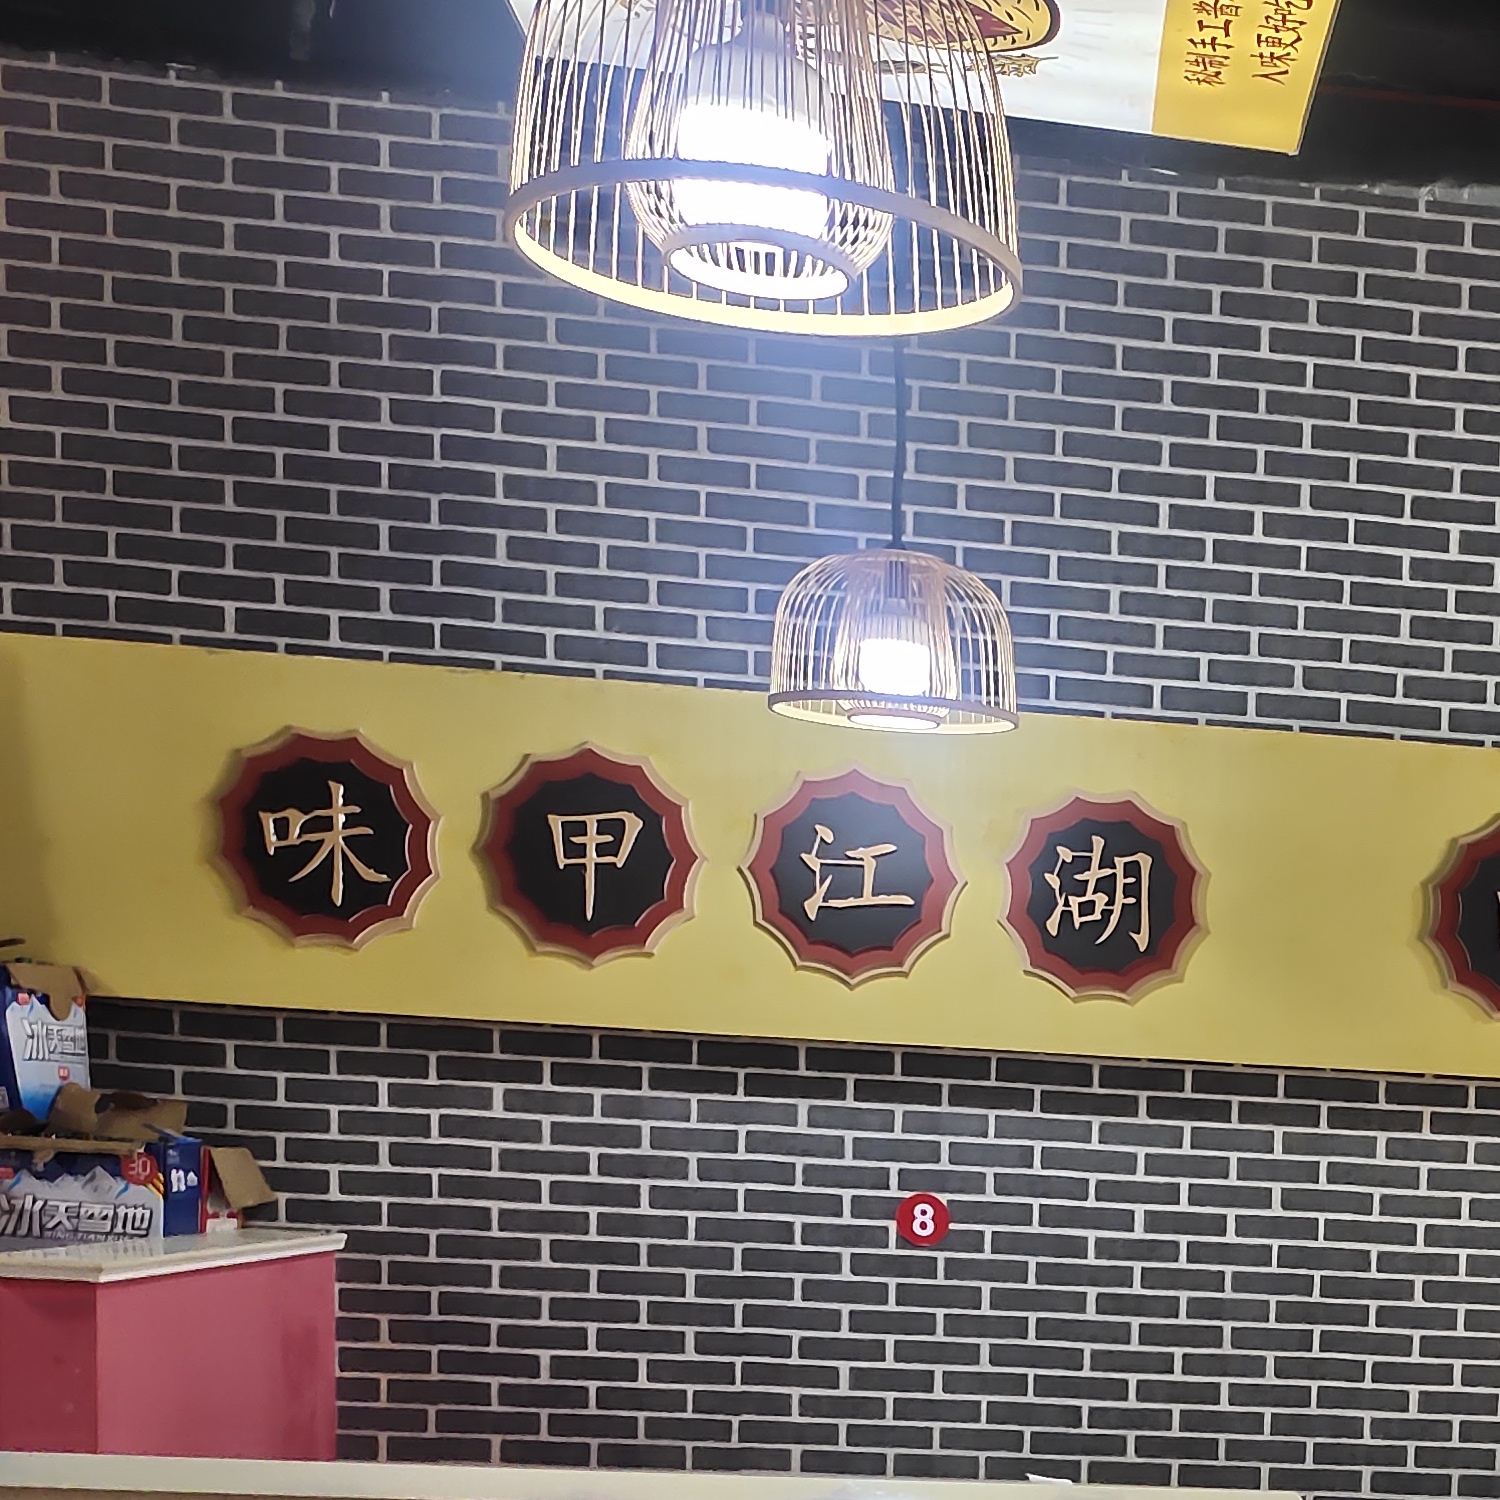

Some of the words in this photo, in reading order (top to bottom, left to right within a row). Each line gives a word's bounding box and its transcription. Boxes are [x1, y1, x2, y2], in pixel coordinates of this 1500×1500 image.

[257, 780, 1153, 955] 味甲江湖
[0, 1194, 152, 1238] 冰天雪地
[912, 1203, 935, 1237] 8
